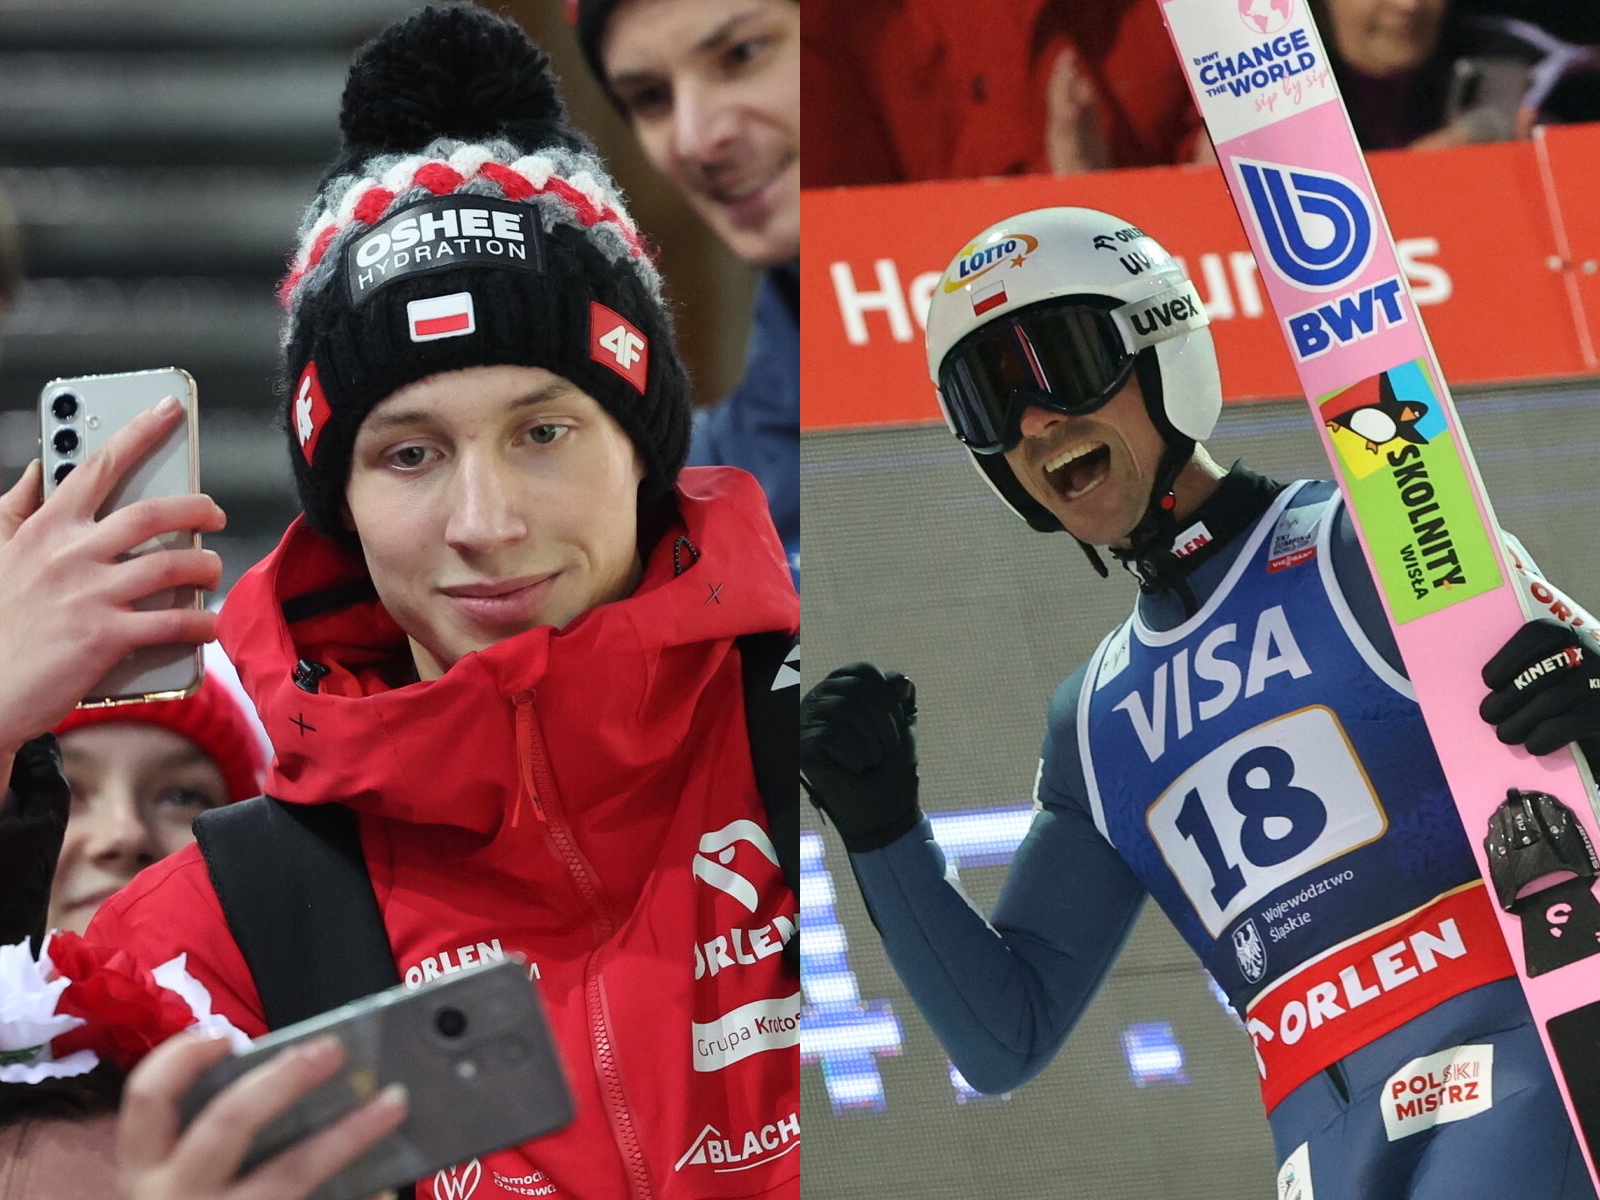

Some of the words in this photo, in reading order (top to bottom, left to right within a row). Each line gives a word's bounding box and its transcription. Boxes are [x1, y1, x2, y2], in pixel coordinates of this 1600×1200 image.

[1200, 28, 1310, 85] CHANGE
[1206, 85, 1228, 97] THE
[1227, 52, 1316, 97] WORLD
[1255, 92, 1278, 112] sip
[1282, 70, 1302, 105] by
[1306, 68, 1329, 89] sip
[357, 209, 524, 267] OSHEE
[960, 240, 1017, 278] LOTTO
[358, 239, 526, 290] HYDRATION
[1130, 294, 1198, 335] uvex
[1287, 277, 1406, 360] BWT
[599, 325, 645, 370] 4F
[1387, 444, 1466, 588] SKOLNITY
[1176, 533, 1208, 558] LEN
[1400, 544, 1429, 600] WISŁA
[1112, 605, 1313, 763] VISA
[1175, 746, 1328, 912] 18
[1261, 870, 1354, 923] Województwo
[1269, 912, 1312, 943] Śląskie
[405, 938, 505, 991] ORLEN
[1280, 918, 1467, 1045] ORLEN
[697, 1026, 751, 1057] Grupa
[1392, 1061, 1480, 1100] POLSKI
[1395, 1082, 1479, 1122] MISTRZ
